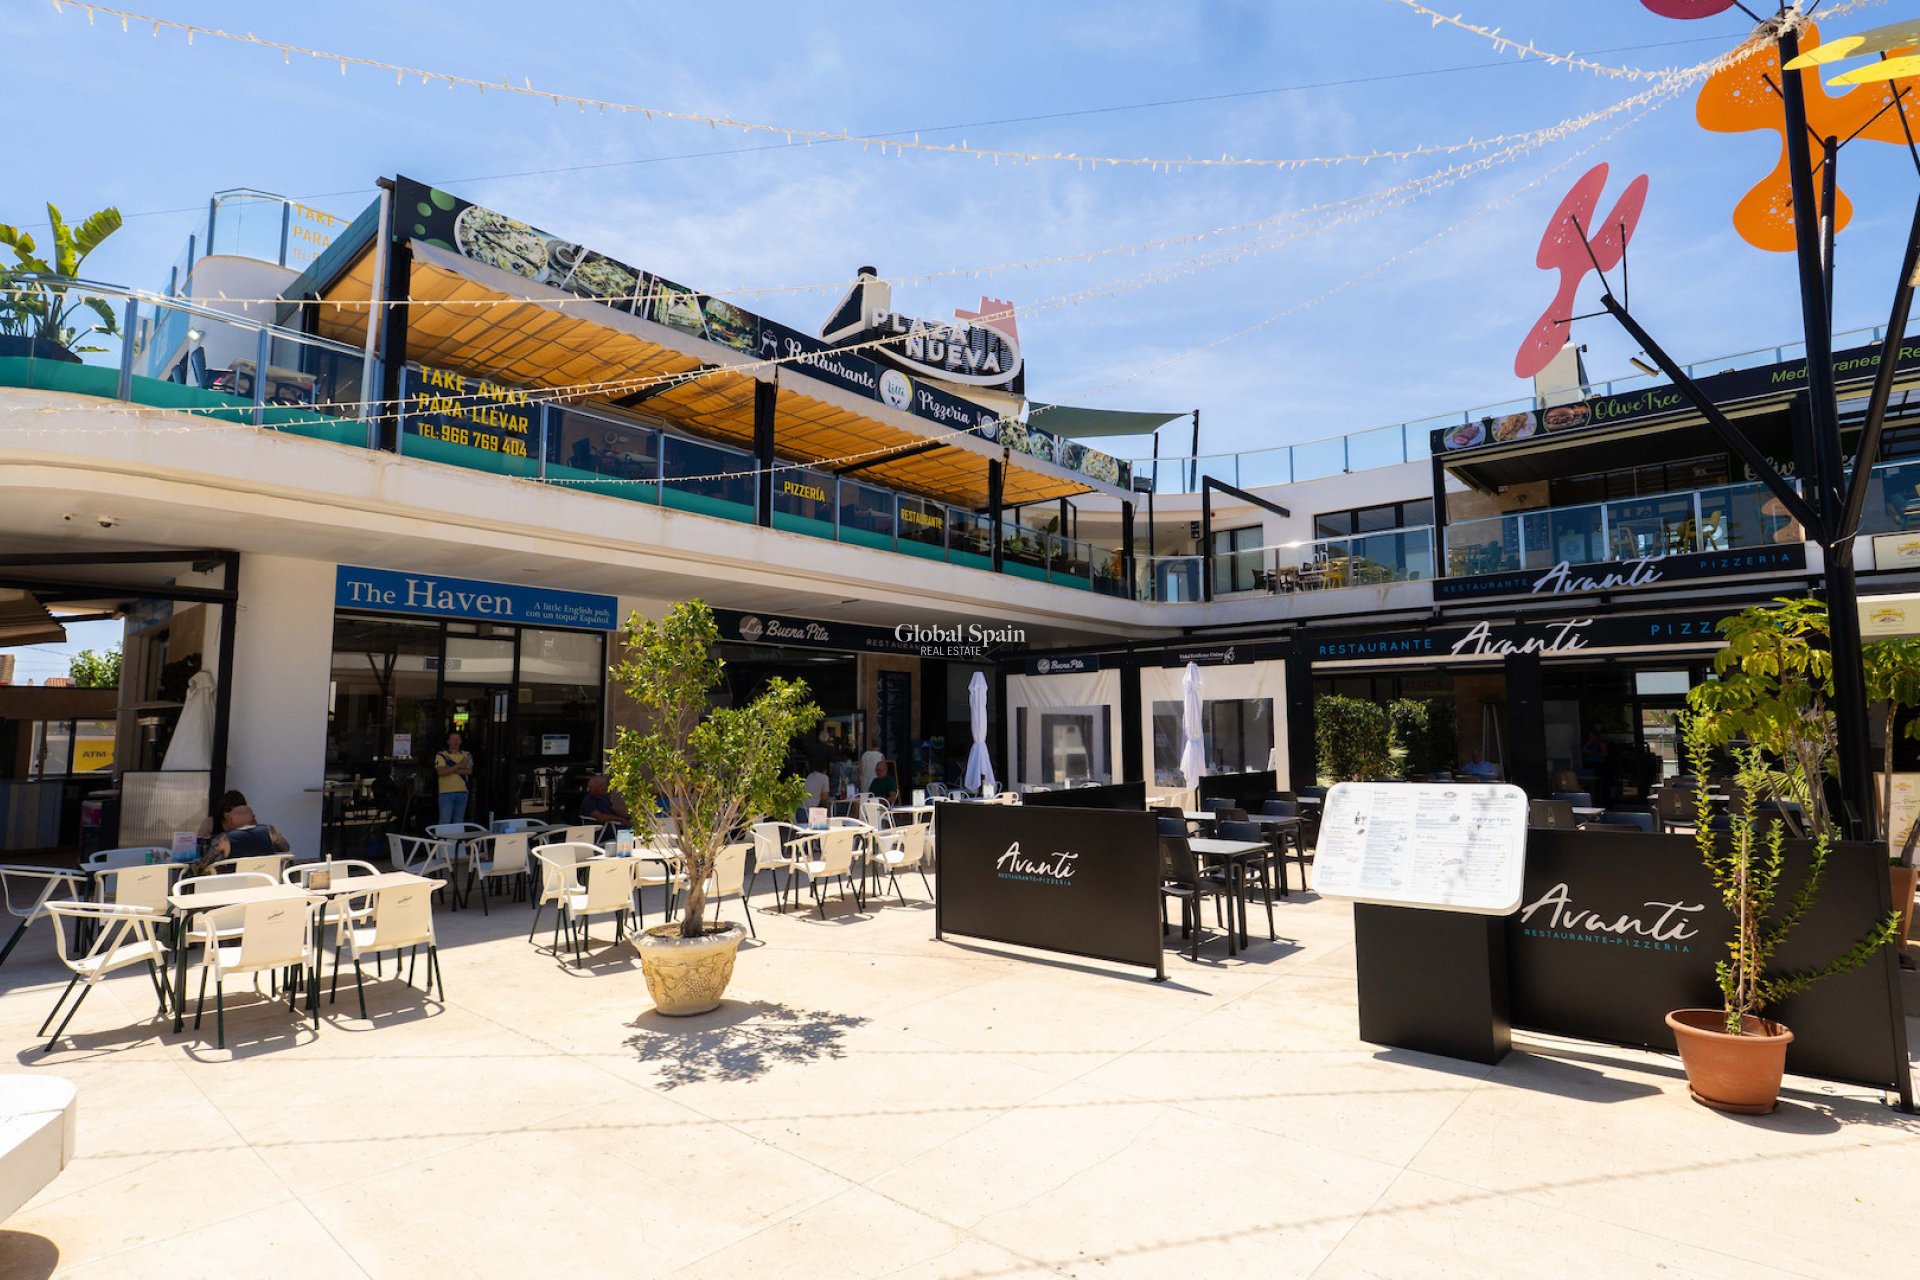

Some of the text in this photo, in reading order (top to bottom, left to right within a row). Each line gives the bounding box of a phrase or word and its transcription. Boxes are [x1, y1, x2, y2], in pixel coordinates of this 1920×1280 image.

[293, 224, 330, 247] PARA
[872, 307, 968, 345] PLAZA
[784, 337, 876, 389] Restaurante
[905, 338, 1001, 373] NUEVA
[420, 365, 528, 408] TAKE AWAY
[419, 391, 529, 434] PARA LLEVAR
[917, 389, 972, 425] Pizzeria
[418, 422, 528, 458] TEL: 966 769 404
[783, 480, 826, 502] PIZZERÍA
[900, 508, 943, 530] RESTAURANTE
[1443, 553, 1791, 595] RESTAURANTE Avanti PIZZERIA
[346, 578, 514, 616] The Haven
[533, 601, 541, 610] A
[543, 602, 562, 612] little
[564, 604, 593, 616] English
[543, 611, 554, 619] un
[555, 613, 578, 623] toque
[740, 616, 830, 642] La Buena Pita
[1319, 638, 1433, 655] RESTAURANTE
[1451, 620, 1593, 657] Avanti
[996, 841, 1079, 879] Avanti
[1520, 882, 1705, 941] Avanti
